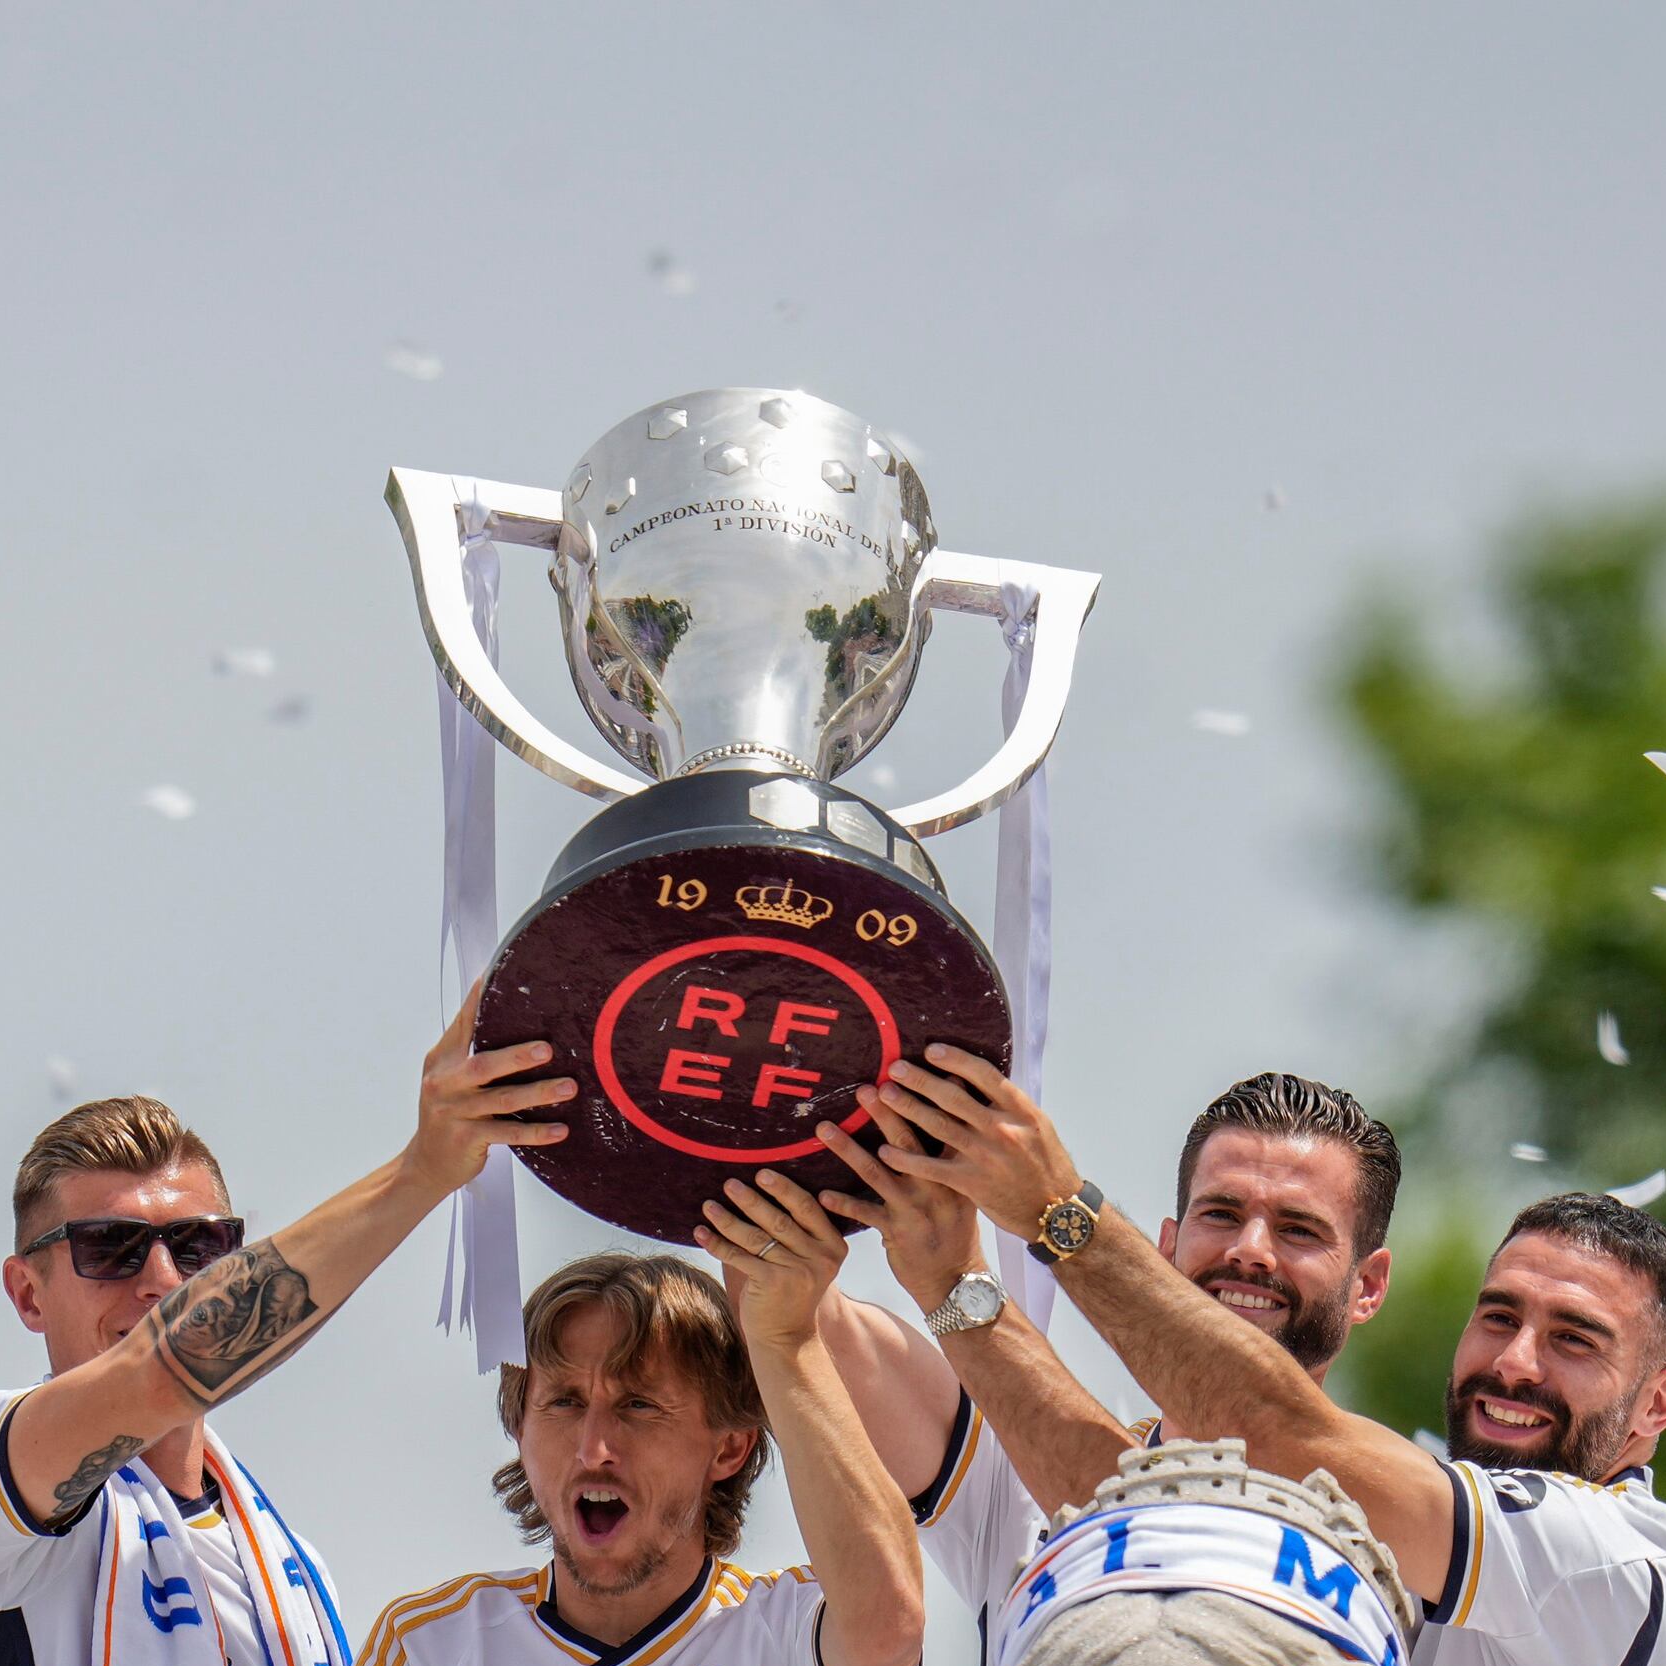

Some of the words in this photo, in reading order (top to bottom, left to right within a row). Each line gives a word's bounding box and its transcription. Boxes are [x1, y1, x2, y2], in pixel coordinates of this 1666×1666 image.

[608, 498, 745, 553] CAMPEONATO
[860, 533, 882, 558] DE
[739, 516, 838, 549] DIVISIÓN
[655, 873, 708, 912] 19
[854, 908, 918, 947] 09
